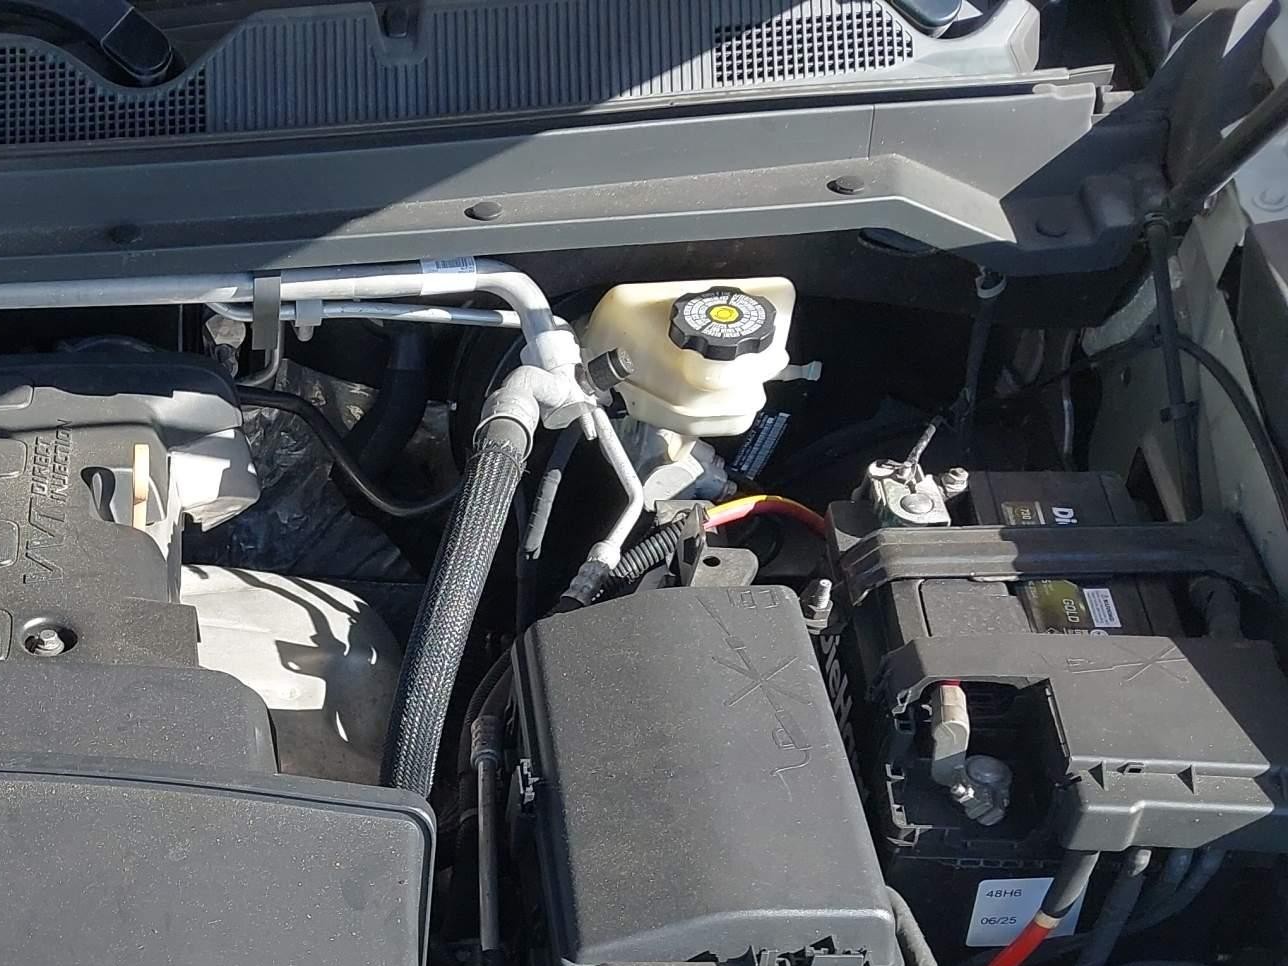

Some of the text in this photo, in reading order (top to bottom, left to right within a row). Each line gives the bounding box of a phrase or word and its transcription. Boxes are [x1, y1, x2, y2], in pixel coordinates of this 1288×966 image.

[31, 435, 50, 498] DIRECT
[50, 418, 73, 504] INJECTION
[1062, 598, 1081, 623] GOLD
[985, 889, 1023, 898] 48H6
[980, 916, 1017, 925] 06/25
